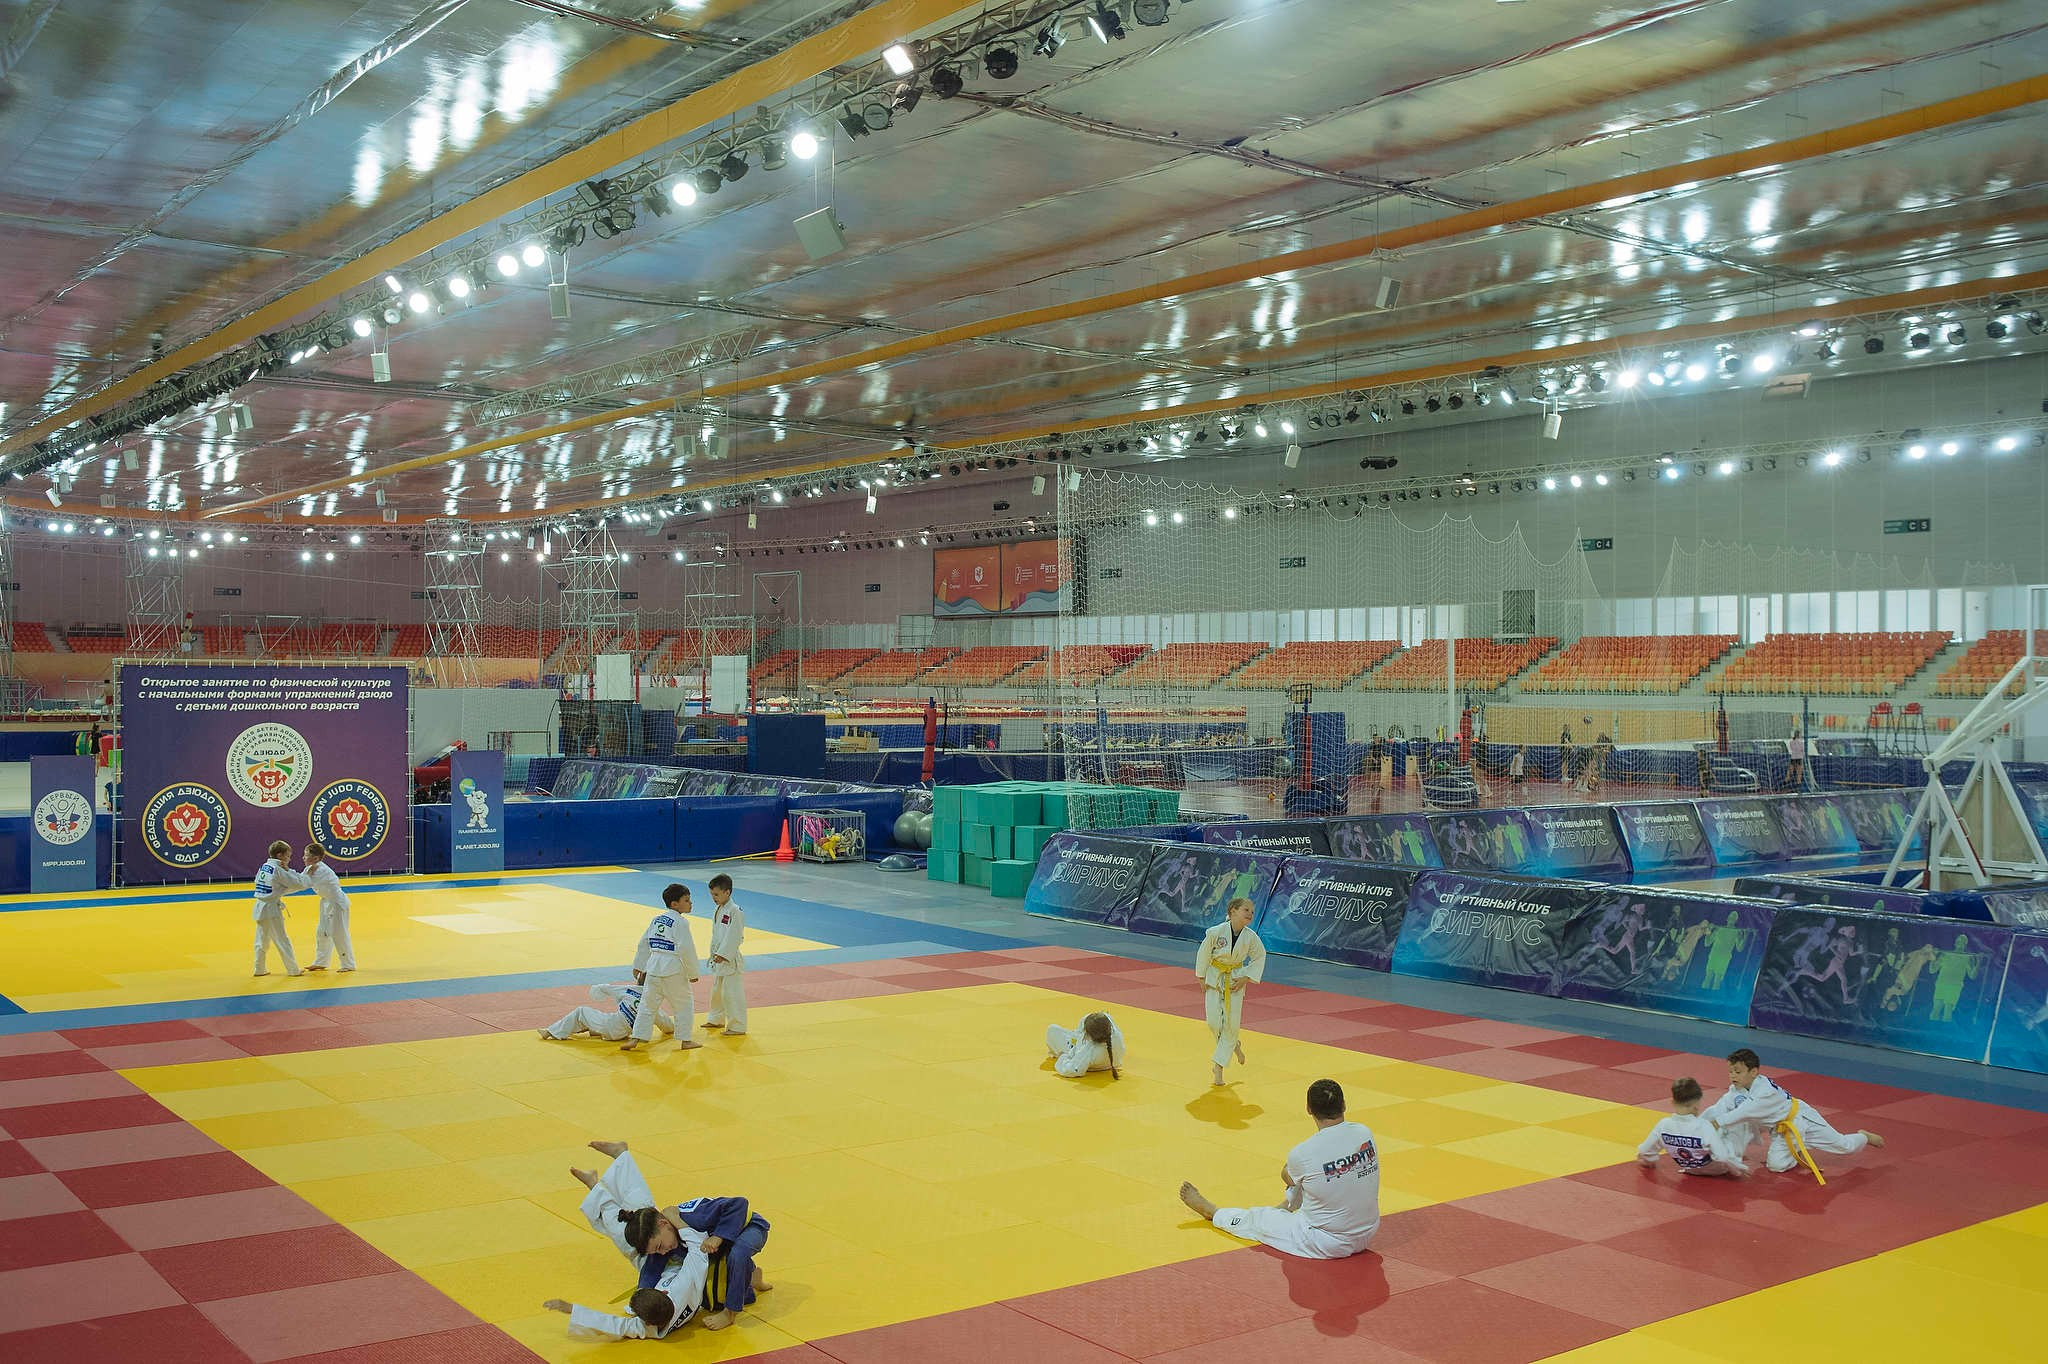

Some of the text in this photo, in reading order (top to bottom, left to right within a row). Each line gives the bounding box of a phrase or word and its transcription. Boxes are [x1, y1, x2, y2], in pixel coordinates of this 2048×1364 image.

[141, 677, 391, 689] Открытое занятие по физической культуре
[138, 689, 393, 700] с начальными формами упражнений дзюдо
[184, 703, 228, 712] детьми
[229, 702, 308, 712] дошкольного
[310, 702, 360, 711] возраста
[43, 792, 80, 806] ПЕРВЫЙ
[80, 802, 90, 826] ПОЯС
[313, 784, 385, 842] RUSSIAN JUDO FEDERATION
[147, 787, 226, 849] ФЕДЕРАЦИЯ ДЗЮДО РОССИИ
[46, 831, 80, 844] ДЗЮДО
[1229, 835, 1312, 847] СПРТИВНЫЙ КЛУБ
[175, 852, 200, 863] ФДР
[340, 846, 359, 856] RJF
[1061, 850, 1134, 866] СПРТИВНЫЙ КЛУБ
[1052, 861, 1129, 891] СИРИУС
[1298, 878, 1394, 897] СПРТИВНЫЙ КЛУБ
[1288, 891, 1388, 925] СИРИУС
[1439, 893, 1551, 915] СПРТИВНЫЙ КЛУБ
[1430, 907, 1546, 946] СИРИУС
